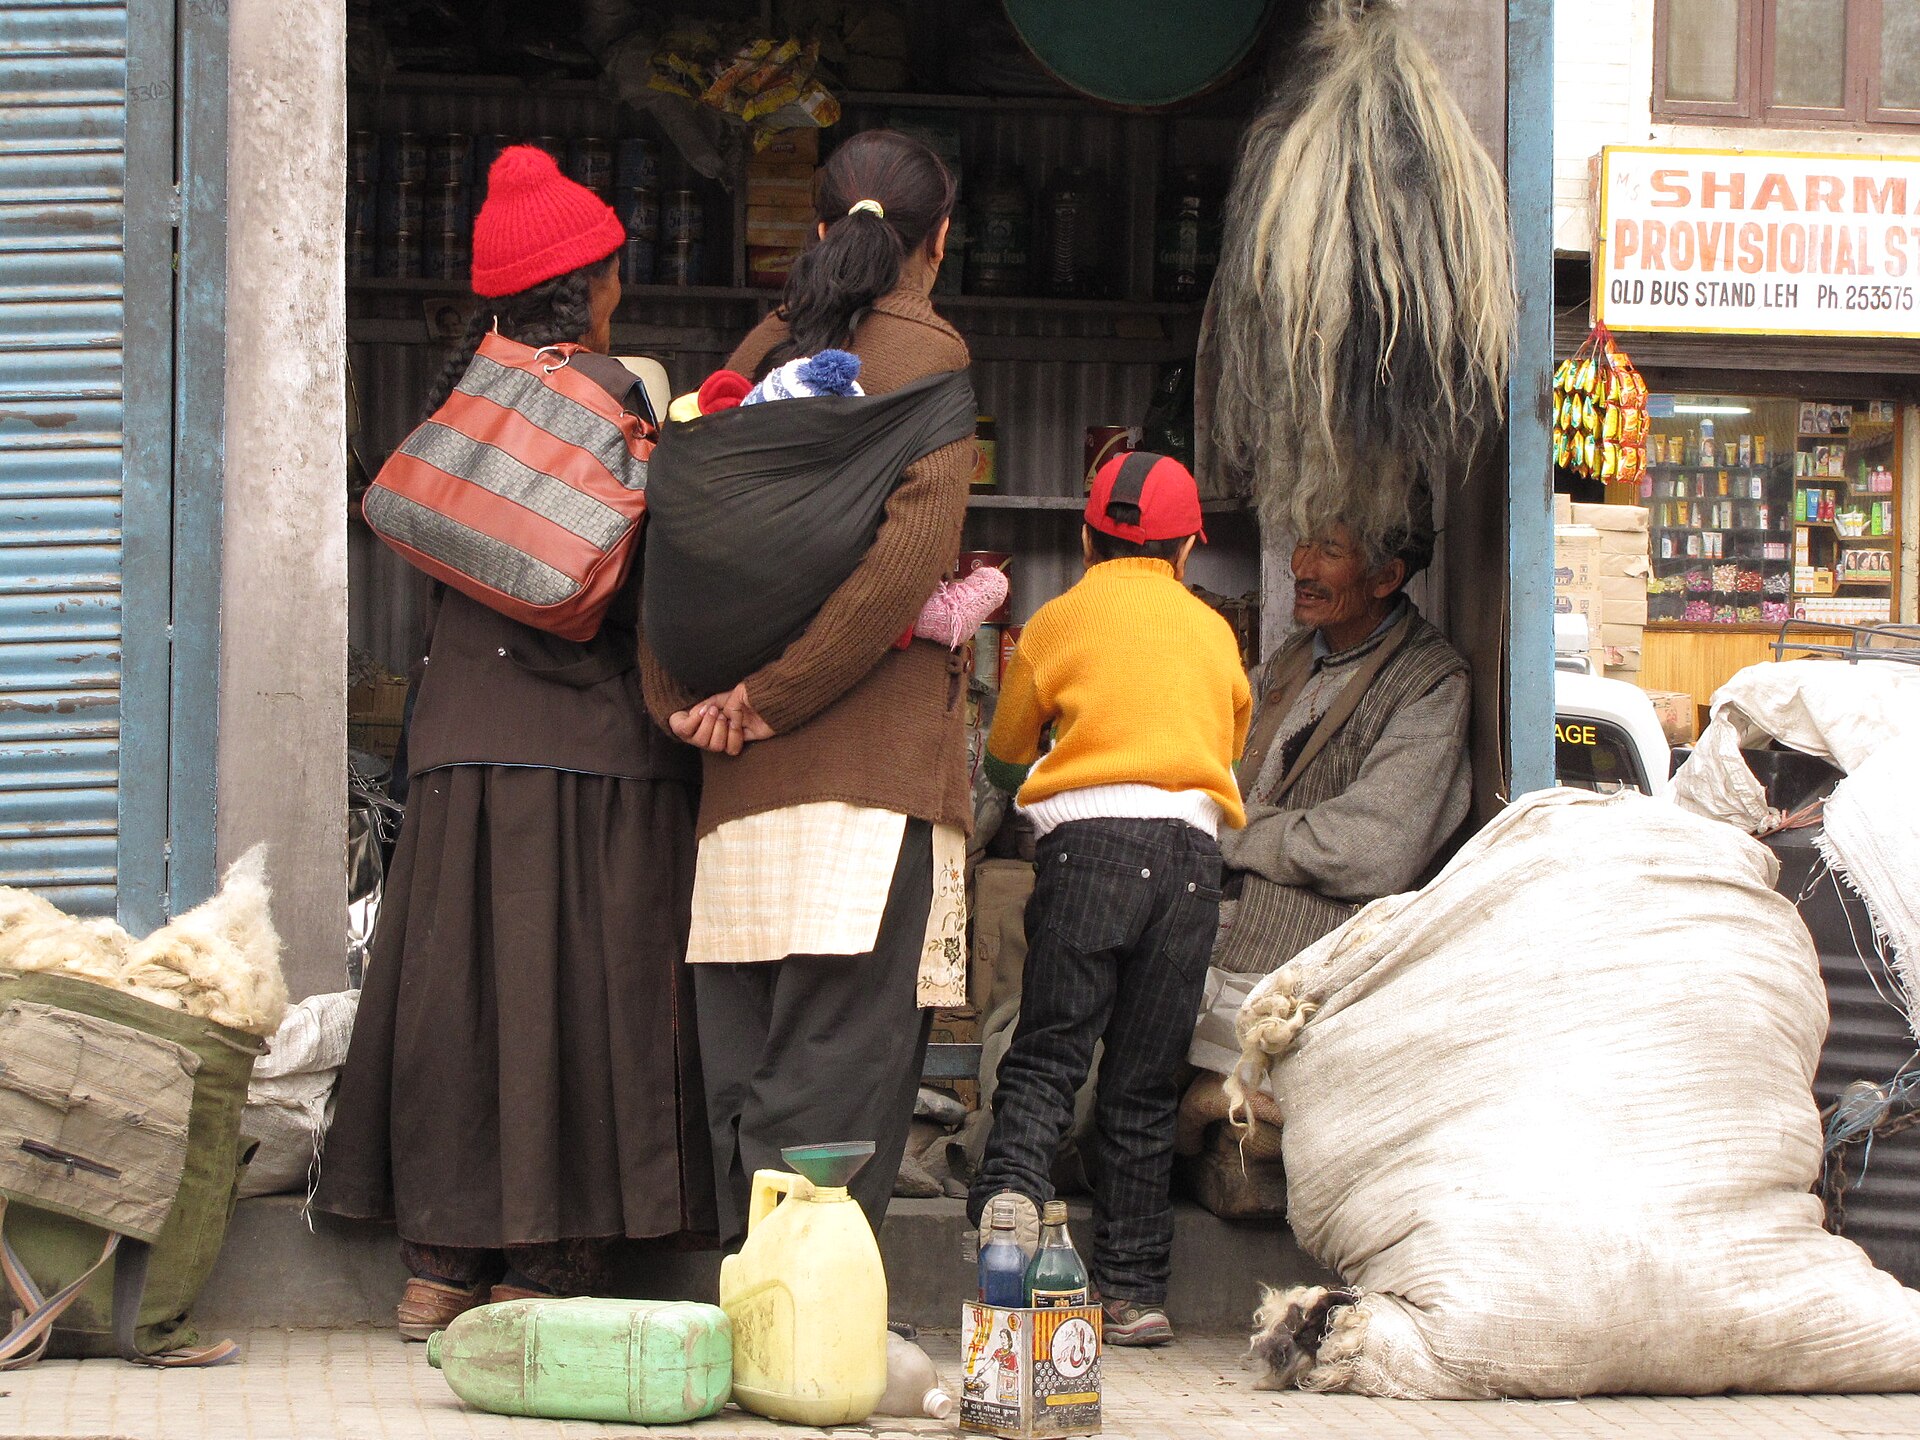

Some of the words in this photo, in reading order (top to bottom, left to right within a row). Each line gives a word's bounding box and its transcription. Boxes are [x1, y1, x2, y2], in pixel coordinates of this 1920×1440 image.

[1650, 169, 1920, 216] SHARM
[1611, 279, 1644, 305] OLD
[1650, 280, 1689, 307] BUS
[1695, 281, 1755, 308] STAND
[1764, 283, 1798, 308] LEH
